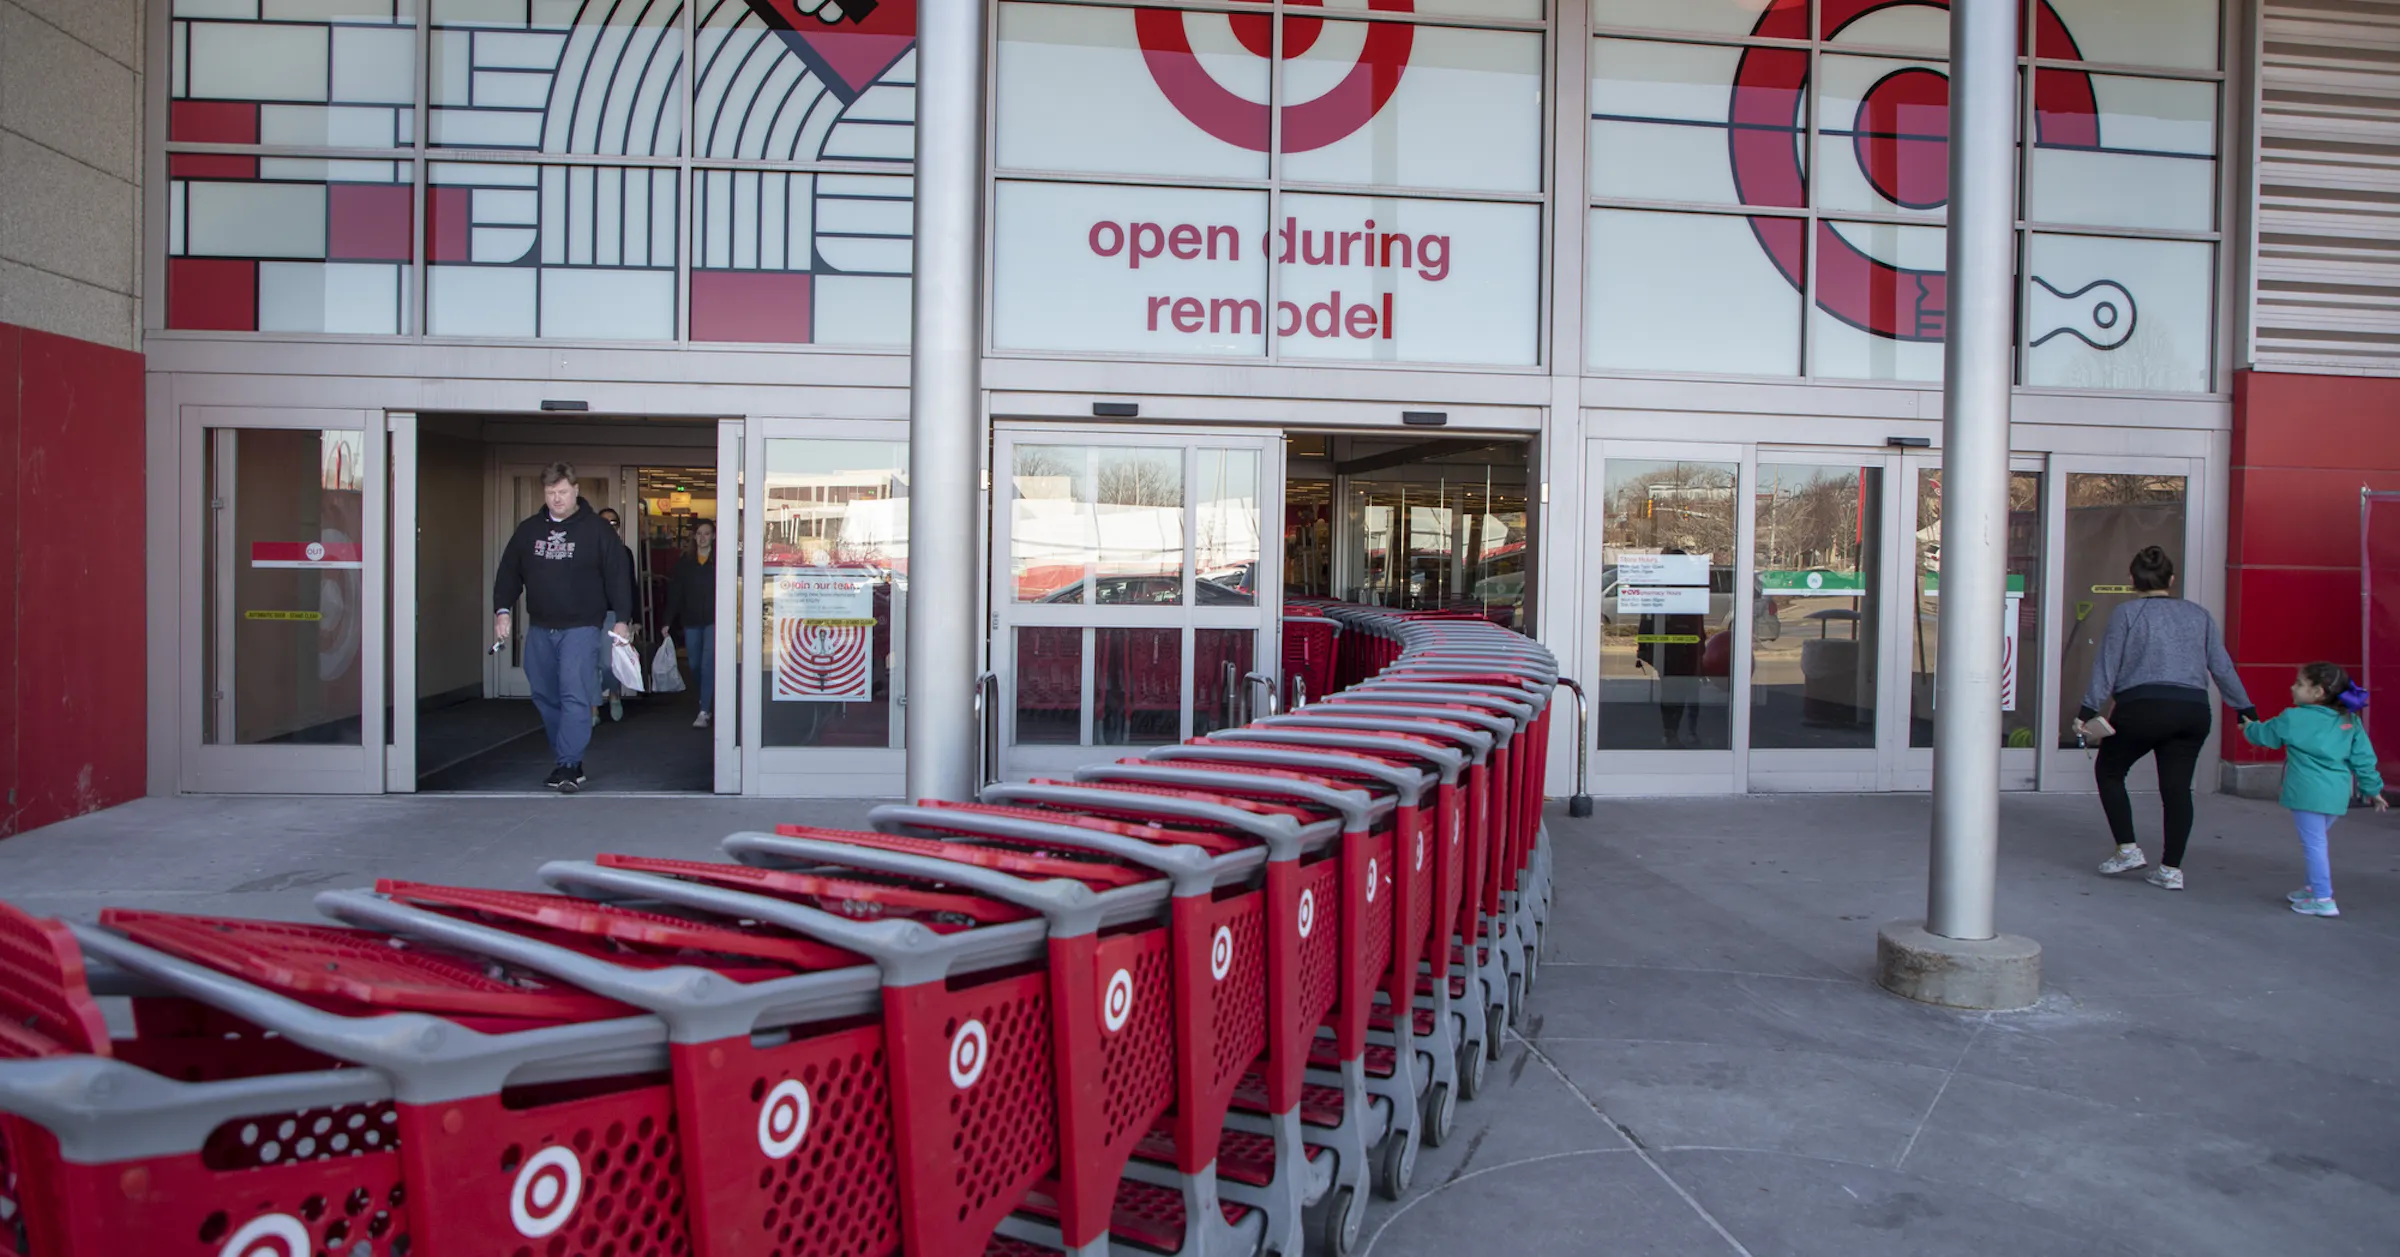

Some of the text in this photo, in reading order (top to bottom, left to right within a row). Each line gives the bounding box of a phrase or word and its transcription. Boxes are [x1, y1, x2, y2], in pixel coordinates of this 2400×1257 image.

[1089, 217, 1450, 281] open during
[1147, 291, 1393, 340] remodel
